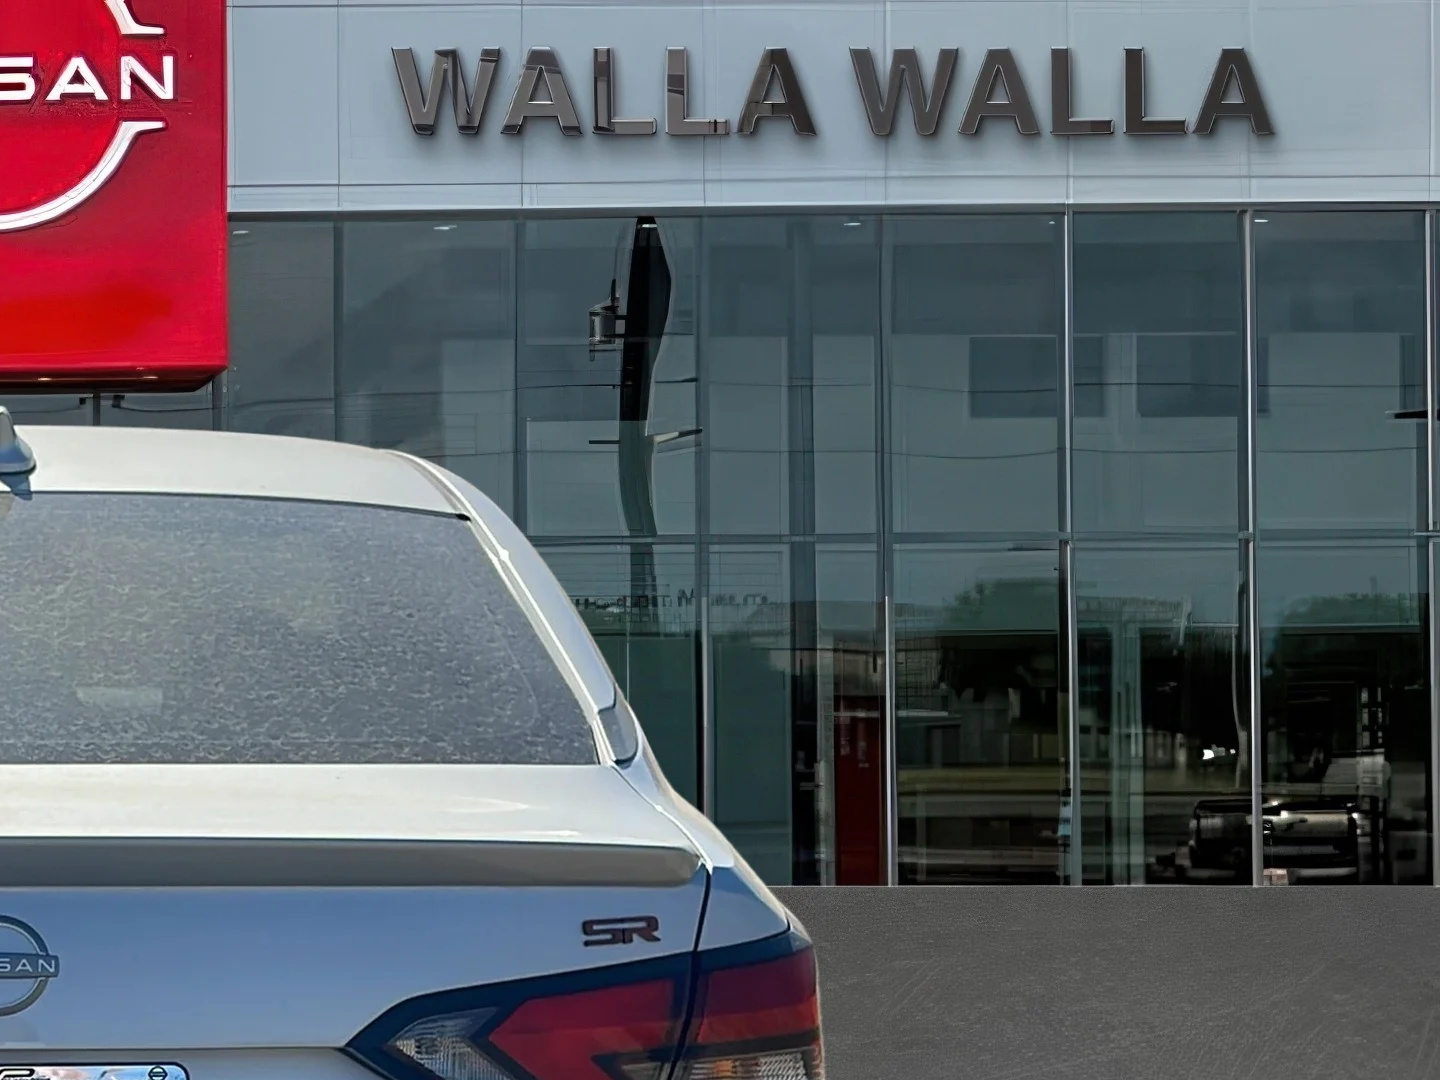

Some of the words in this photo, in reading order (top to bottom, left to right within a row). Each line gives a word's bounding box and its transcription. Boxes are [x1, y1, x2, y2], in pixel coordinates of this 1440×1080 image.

[391, 46, 817, 137] WALLA
[849, 46, 1275, 136] WALLA
[582, 915, 661, 947] SR
